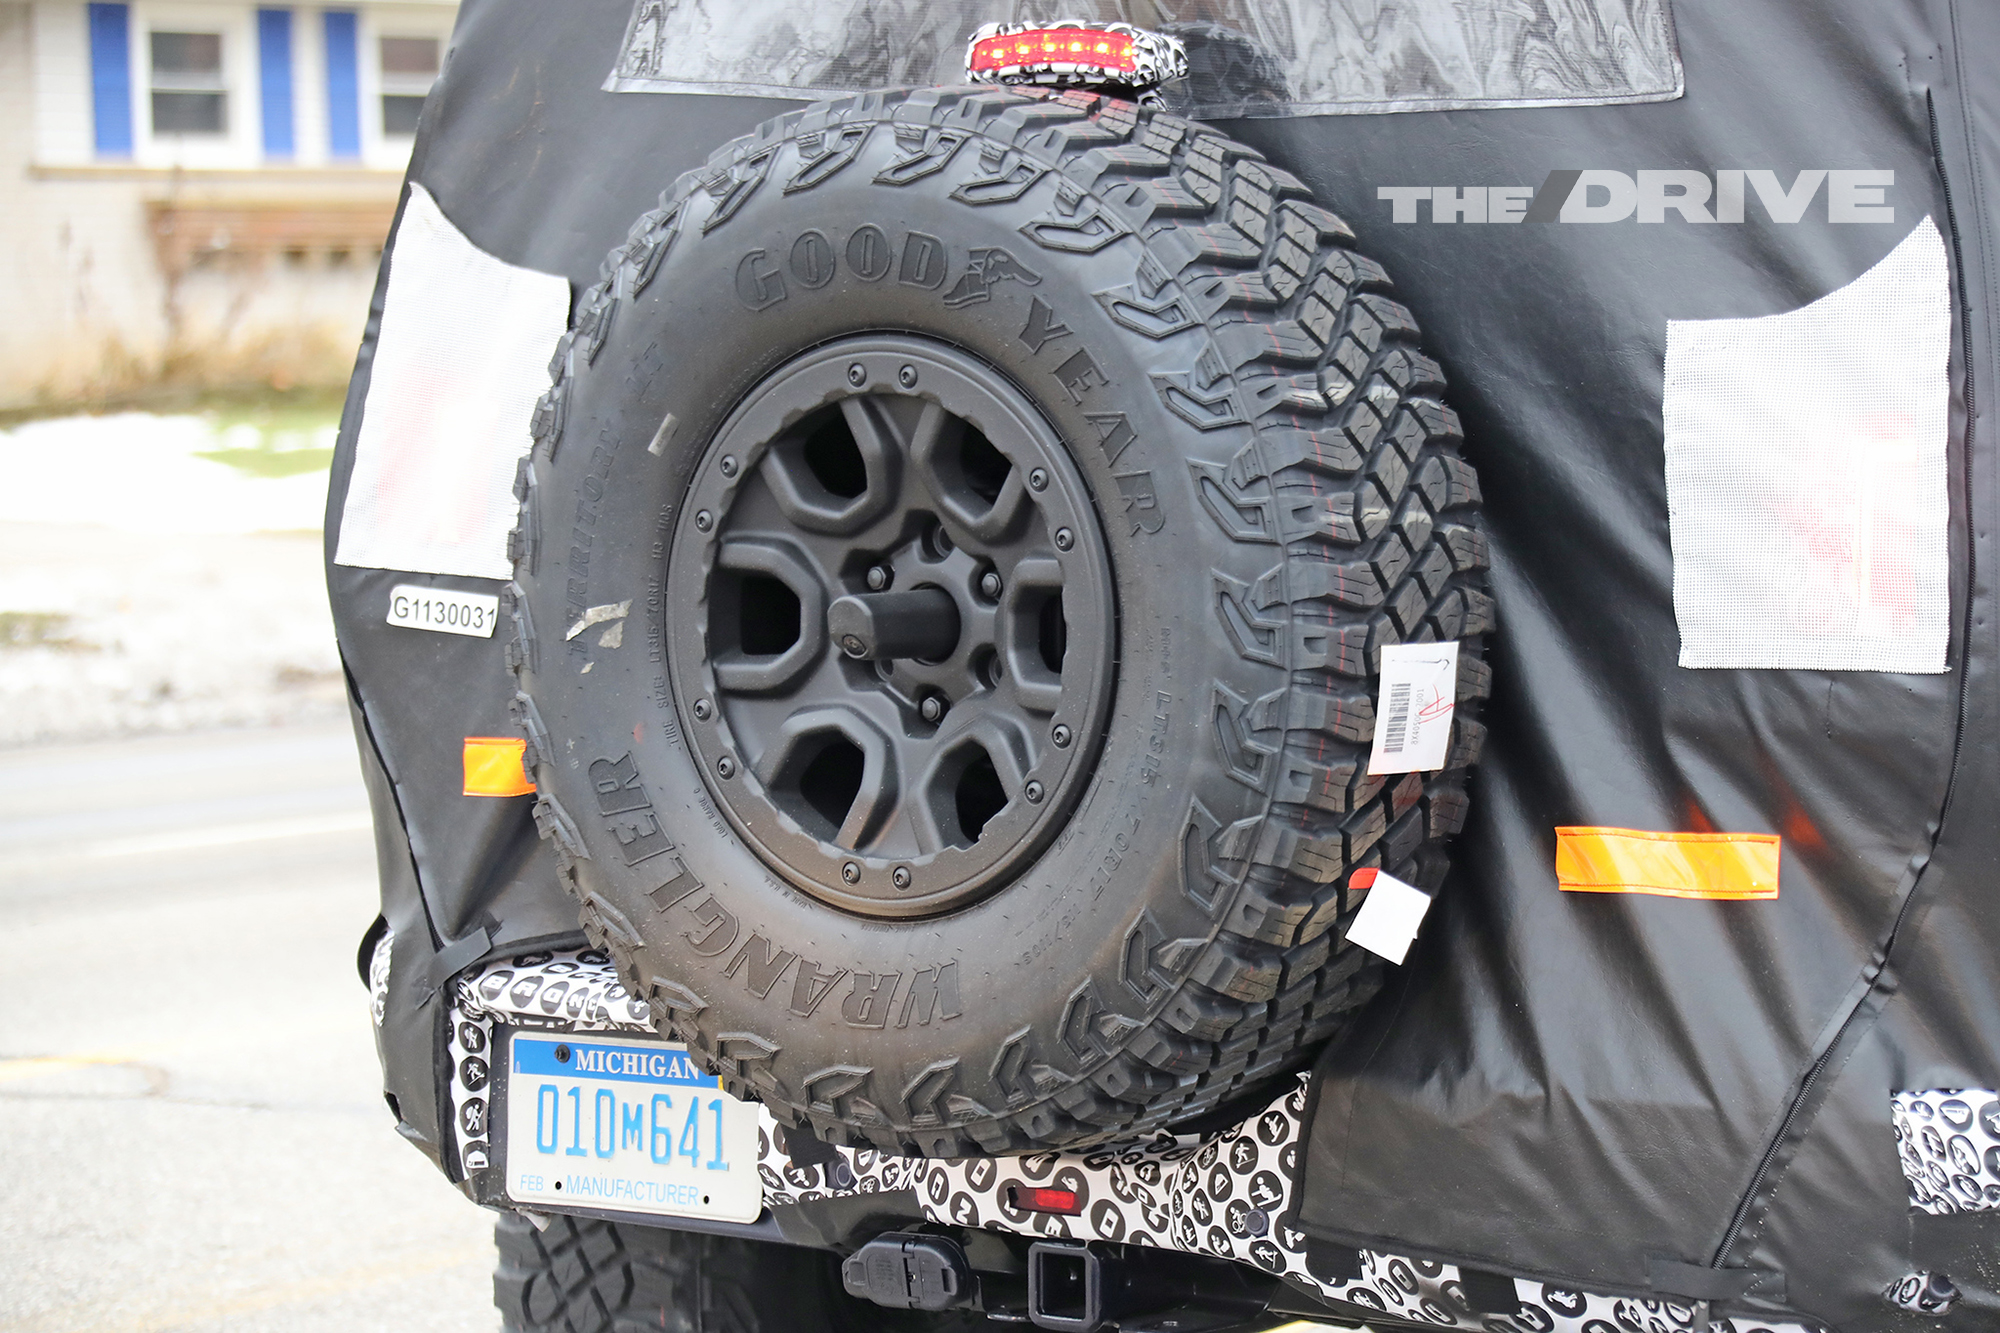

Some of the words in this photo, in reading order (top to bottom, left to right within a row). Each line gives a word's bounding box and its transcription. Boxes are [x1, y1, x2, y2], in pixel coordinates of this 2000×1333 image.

[393, 595, 496, 631] G1130031
[588, 751, 963, 1031] WRANGLER
[575, 1049, 700, 1081] MICHIGAN
[536, 1083, 730, 1172] 010M641
[519, 1174, 545, 1192] FEB
[565, 1174, 700, 1207] MANUFACTURER
